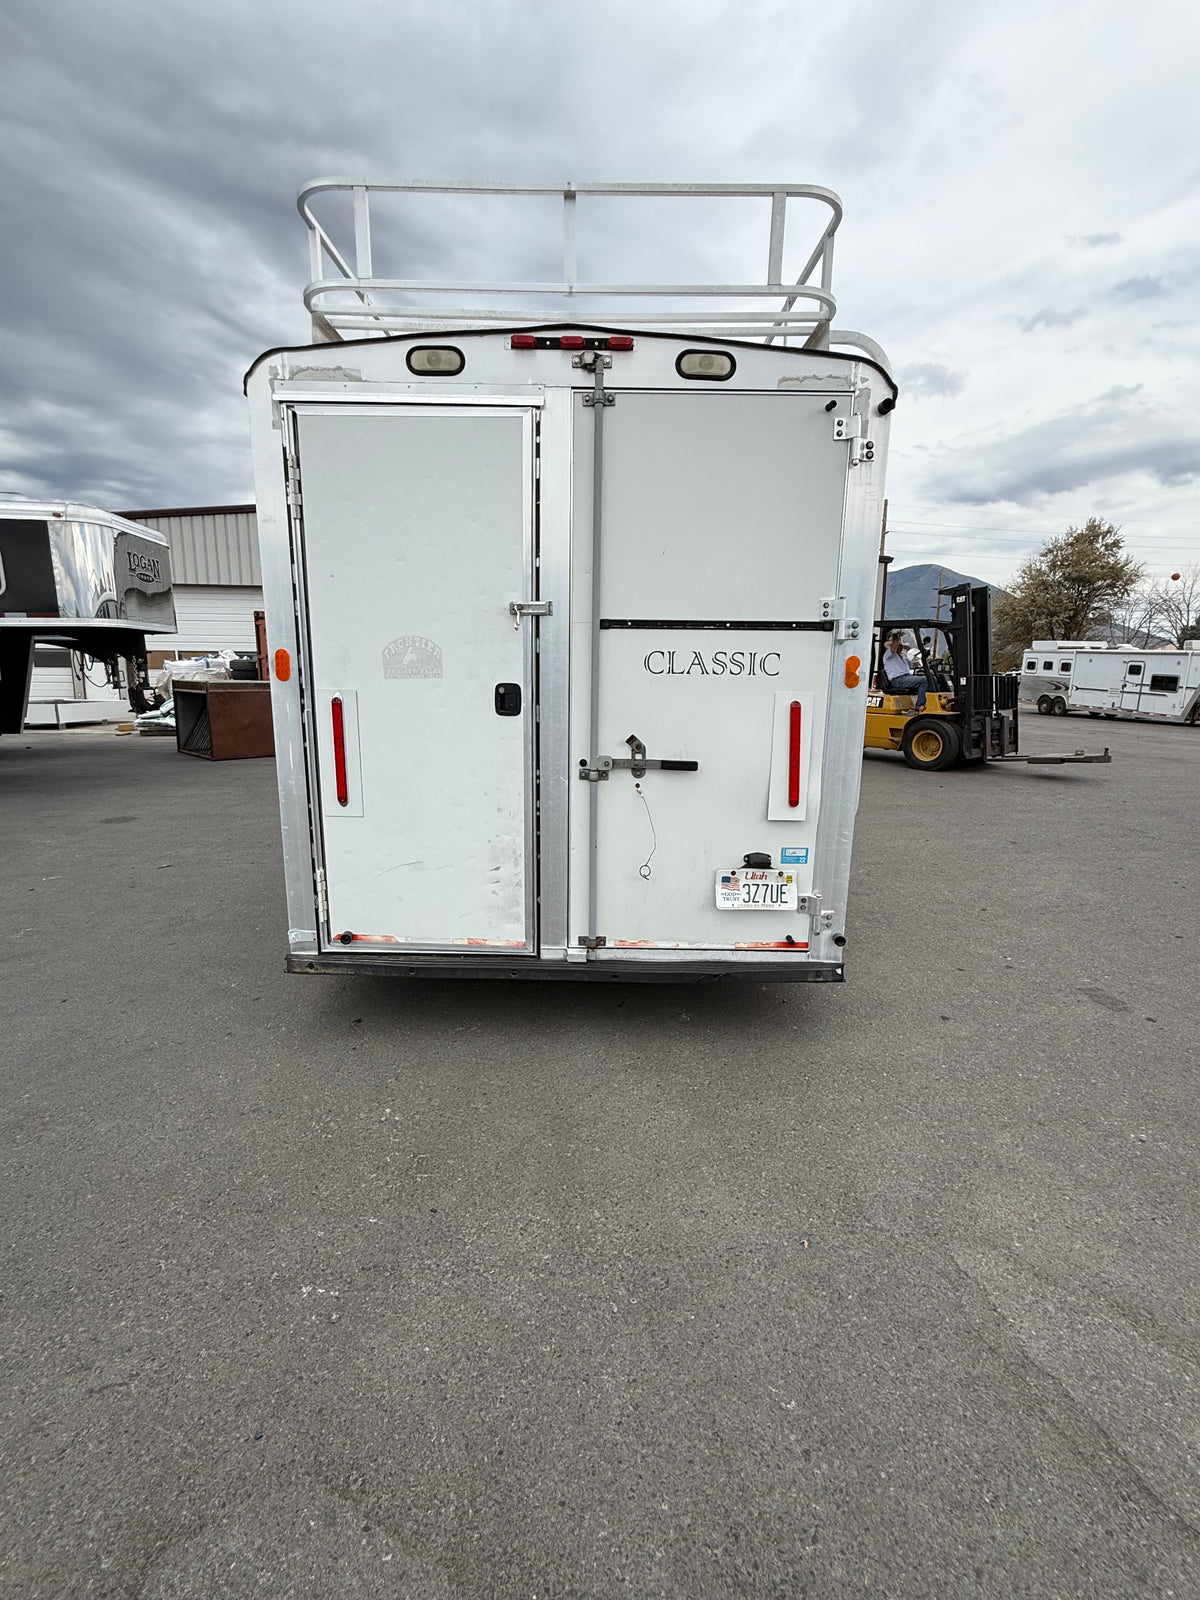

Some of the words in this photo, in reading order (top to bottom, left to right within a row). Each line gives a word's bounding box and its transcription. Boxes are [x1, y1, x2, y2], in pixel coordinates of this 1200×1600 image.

[127, 551, 160, 578] LOGAN
[383, 637, 441, 659] FRONTIER
[643, 650, 781, 677] CLASSIC
[866, 696, 881, 707] CAT
[745, 871, 768, 880] Utah
[742, 883, 788, 904] 3Z7UE
